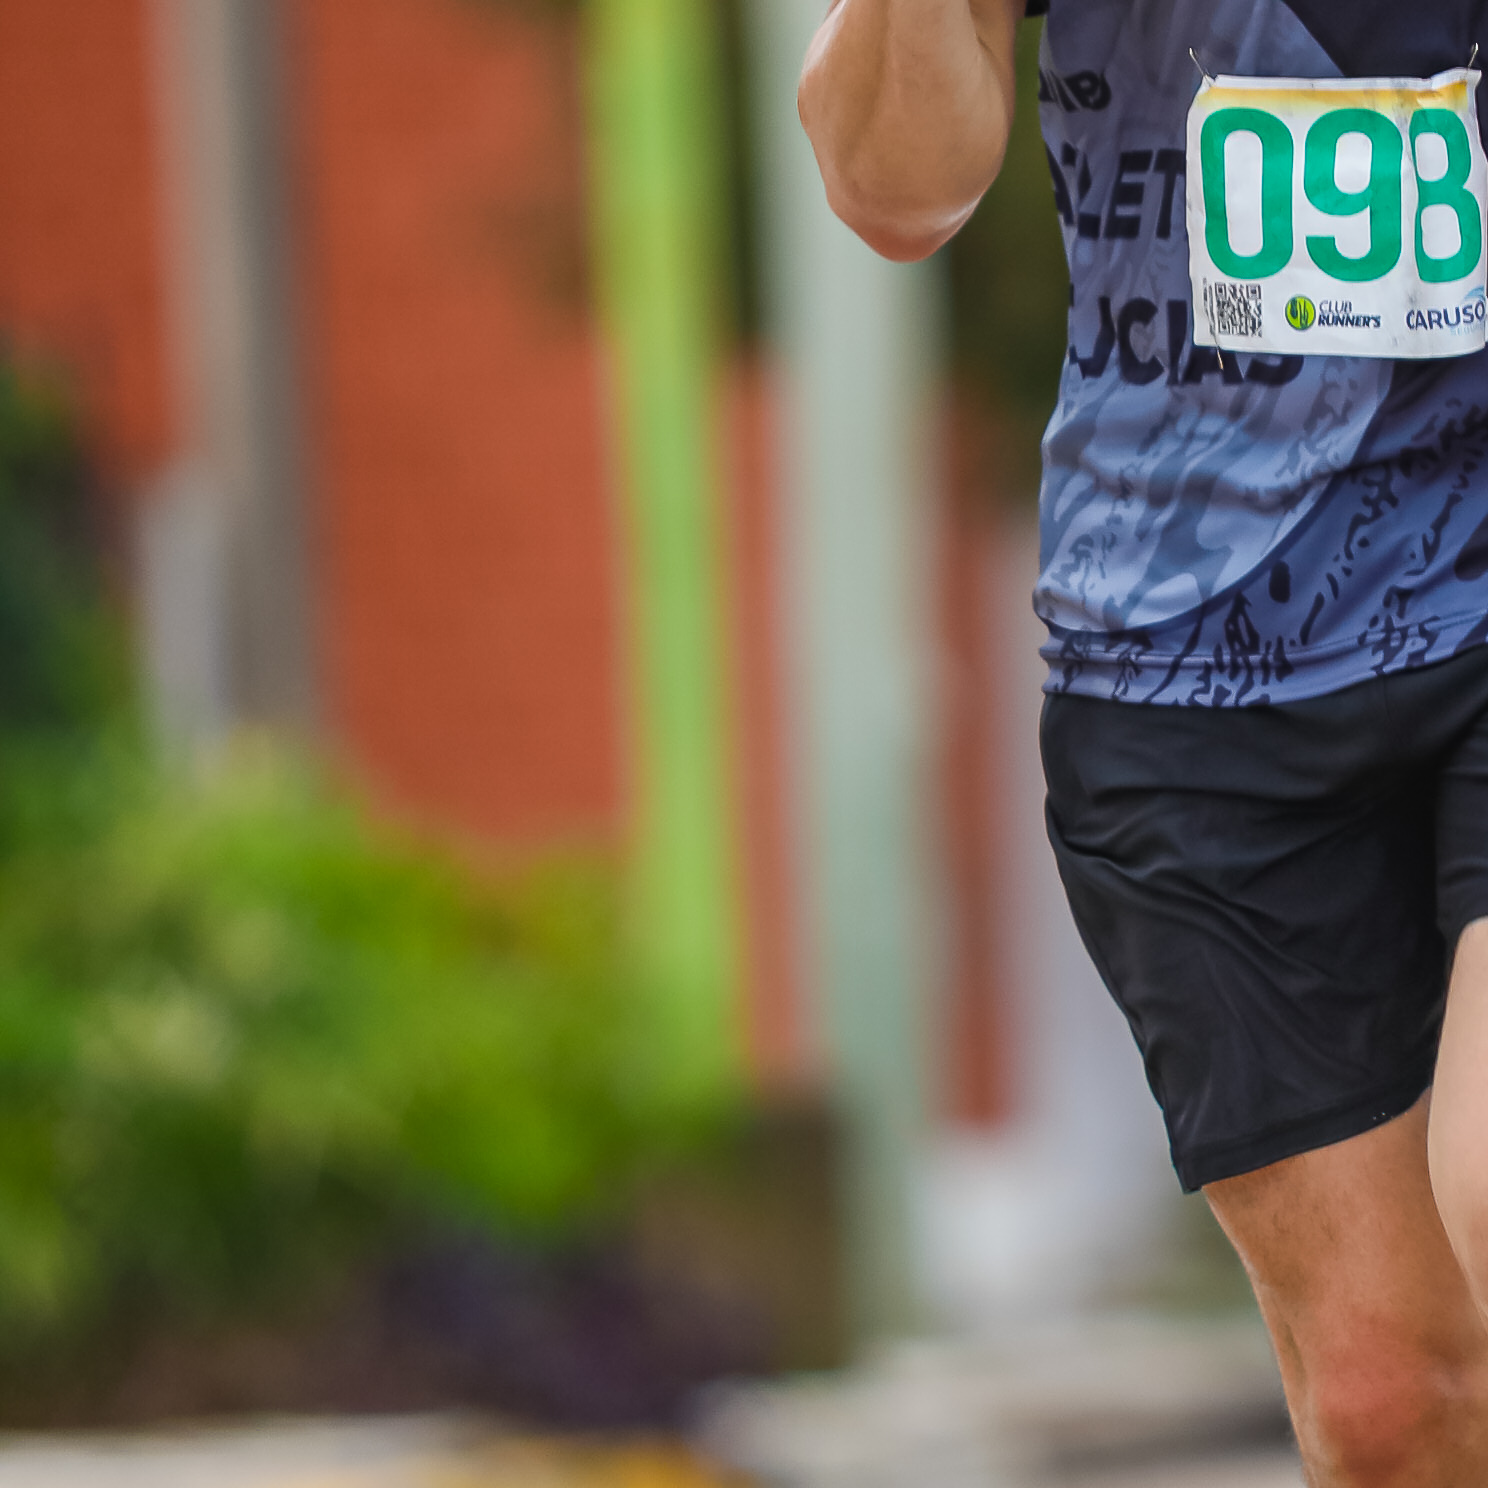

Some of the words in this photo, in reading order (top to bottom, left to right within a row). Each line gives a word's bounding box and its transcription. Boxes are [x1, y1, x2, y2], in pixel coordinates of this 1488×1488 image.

[1200, 107, 1482, 283] 098
[1319, 300, 1352, 313] CLUB
[1405, 300, 1485, 330] CARUSO
